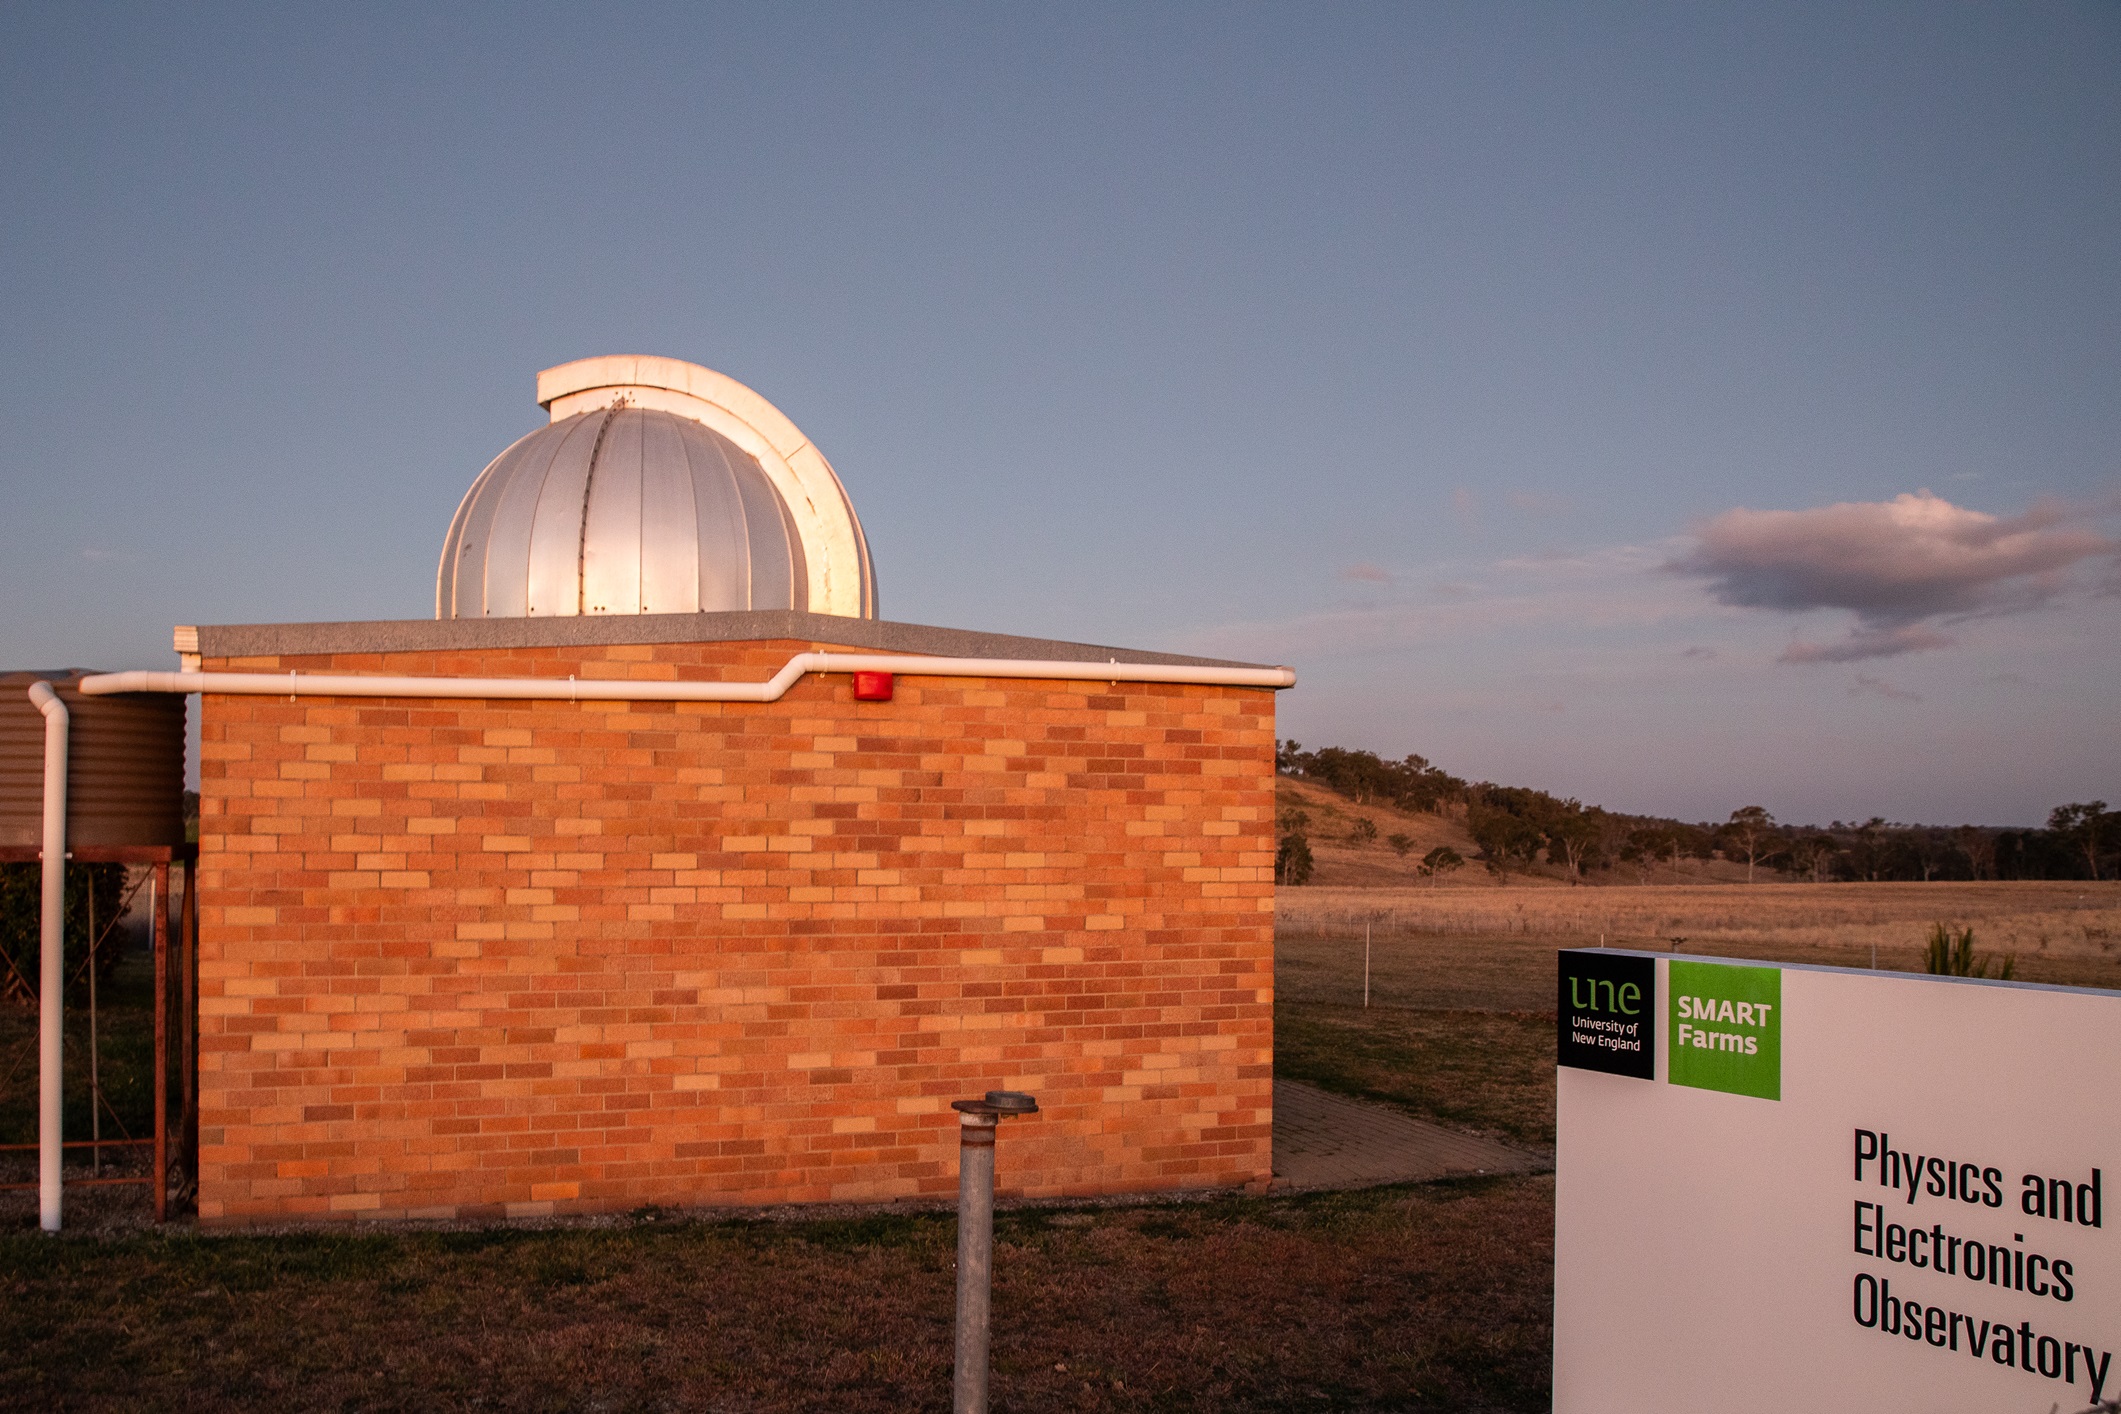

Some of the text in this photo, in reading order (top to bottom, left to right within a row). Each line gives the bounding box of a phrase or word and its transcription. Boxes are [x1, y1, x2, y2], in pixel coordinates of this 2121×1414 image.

[1569, 976, 1641, 1015] une
[1677, 995, 1772, 1027] SMART
[1572, 1016, 1639, 1037] University of
[1572, 1031, 1641, 1051] New England
[1678, 1023, 1758, 1055] Farms
[1854, 1128, 2102, 1229] Physics and
[1854, 1200, 2075, 1302] Electronics
[1853, 1273, 2112, 1406] Observatory
